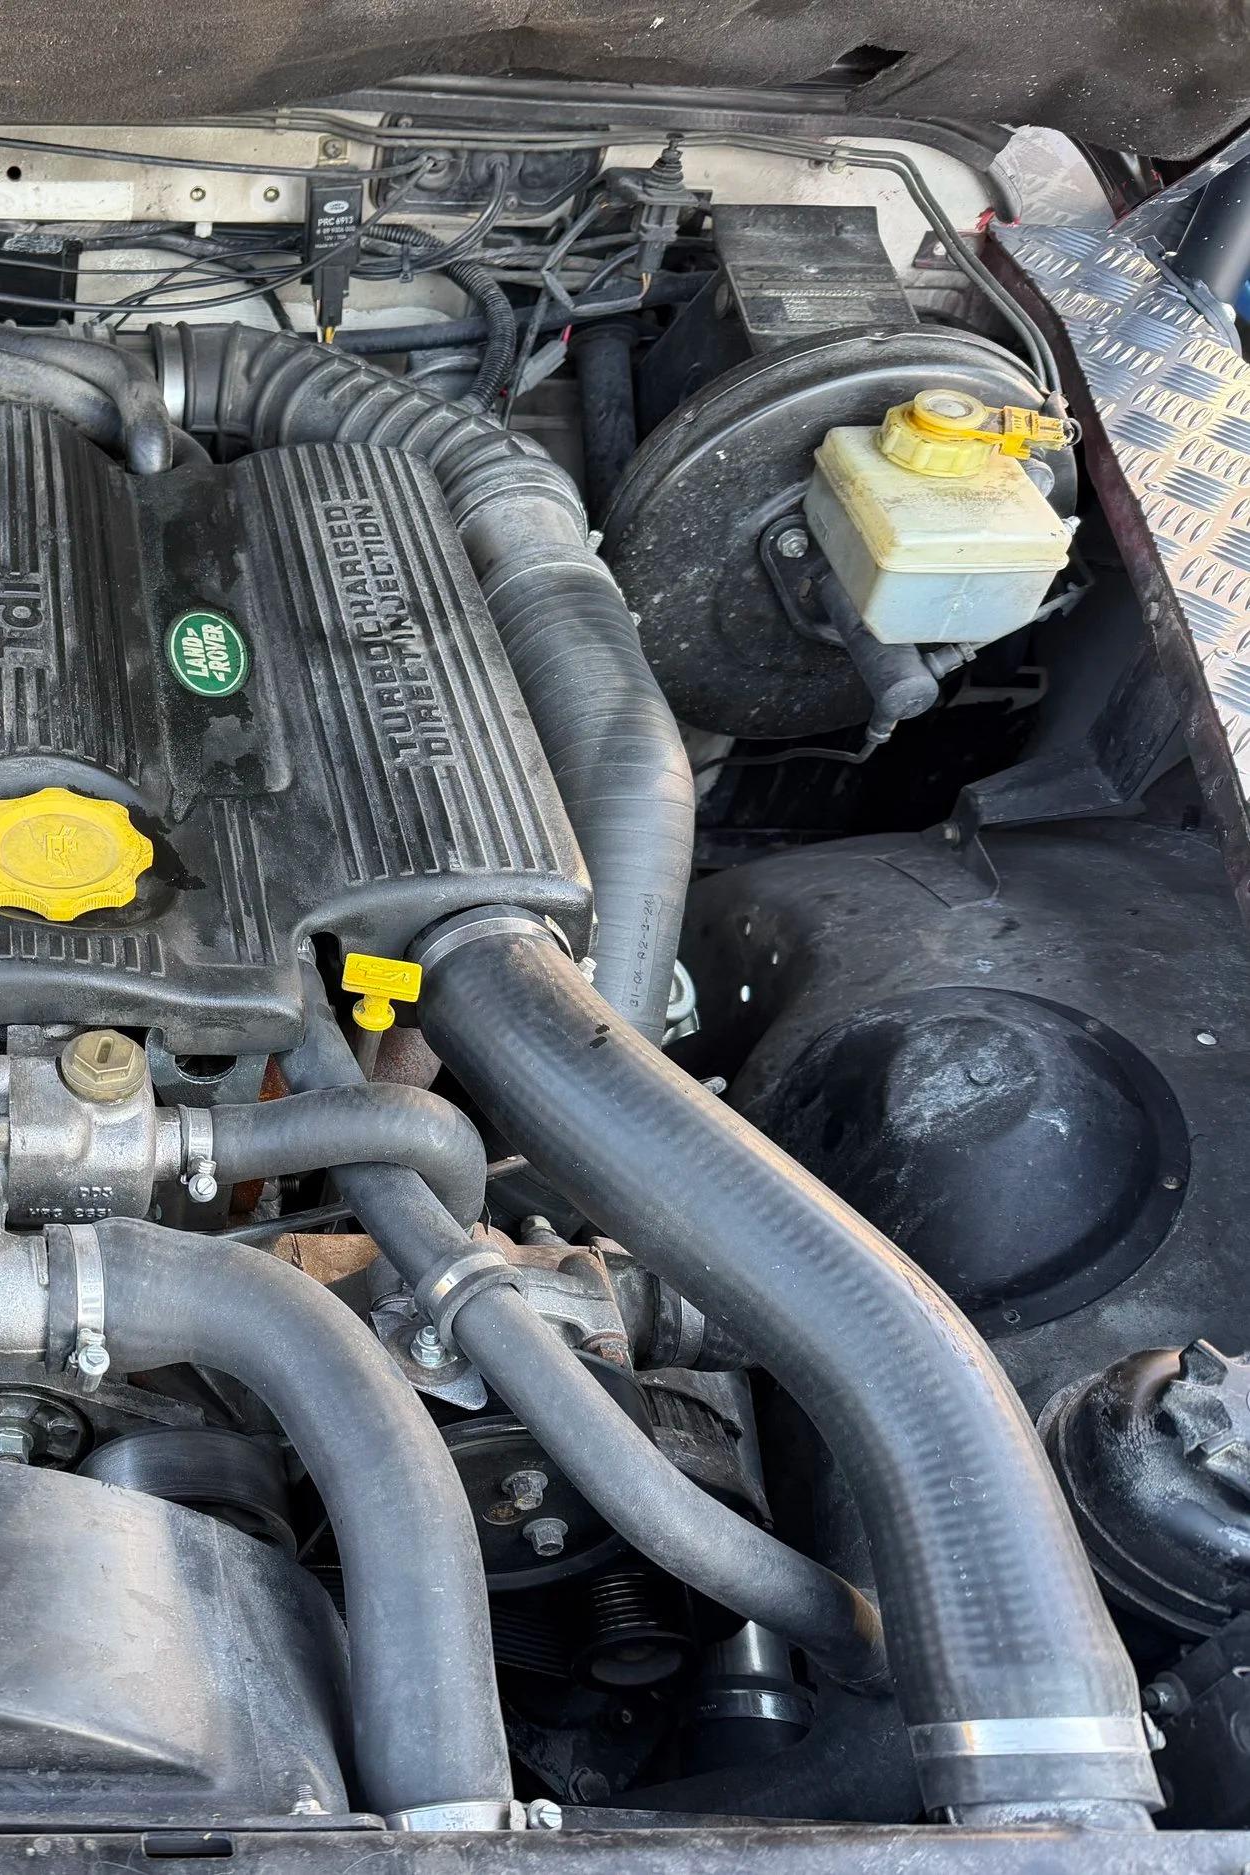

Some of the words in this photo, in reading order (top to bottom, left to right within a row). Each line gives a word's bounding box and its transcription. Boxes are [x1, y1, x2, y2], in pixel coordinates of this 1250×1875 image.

[351, 504, 415, 641] INJECTION
[181, 636, 210, 678] LAND
[201, 624, 231, 673] ROVER
[324, 505, 420, 760] TURBOCHARGED
[400, 651, 454, 757] DIRECT
